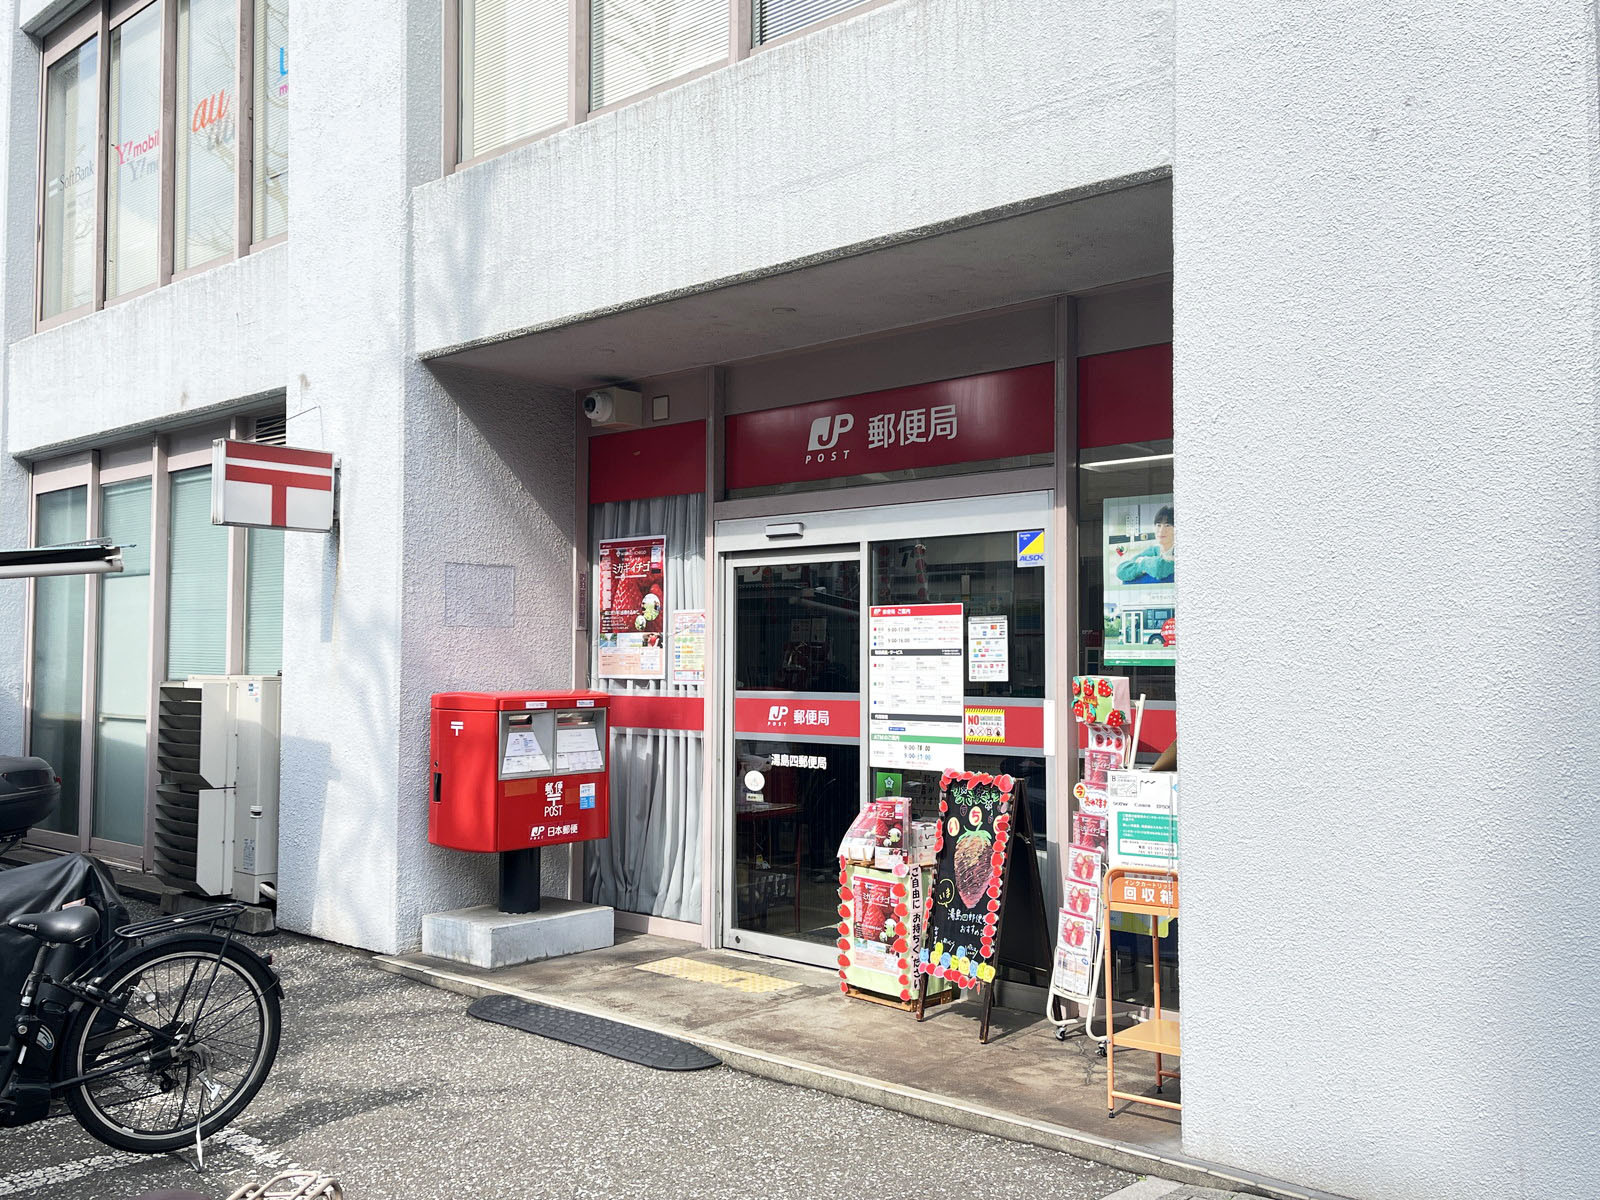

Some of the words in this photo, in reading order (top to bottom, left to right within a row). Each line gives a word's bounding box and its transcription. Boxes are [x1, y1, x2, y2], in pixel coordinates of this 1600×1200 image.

[192, 89, 230, 133] au
[60, 160, 95, 191] SoftBank
[868, 404, 958, 449] 郵便局
[805, 449, 850, 464] POST
[794, 709, 830, 726] 郵便局
[968, 715, 979, 725] NO
[545, 781, 563, 795] 郵便
[544, 805, 563, 817] POST
[547, 824, 578, 836] 日本郵便
[1124, 886, 1173, 904] 回収箱
